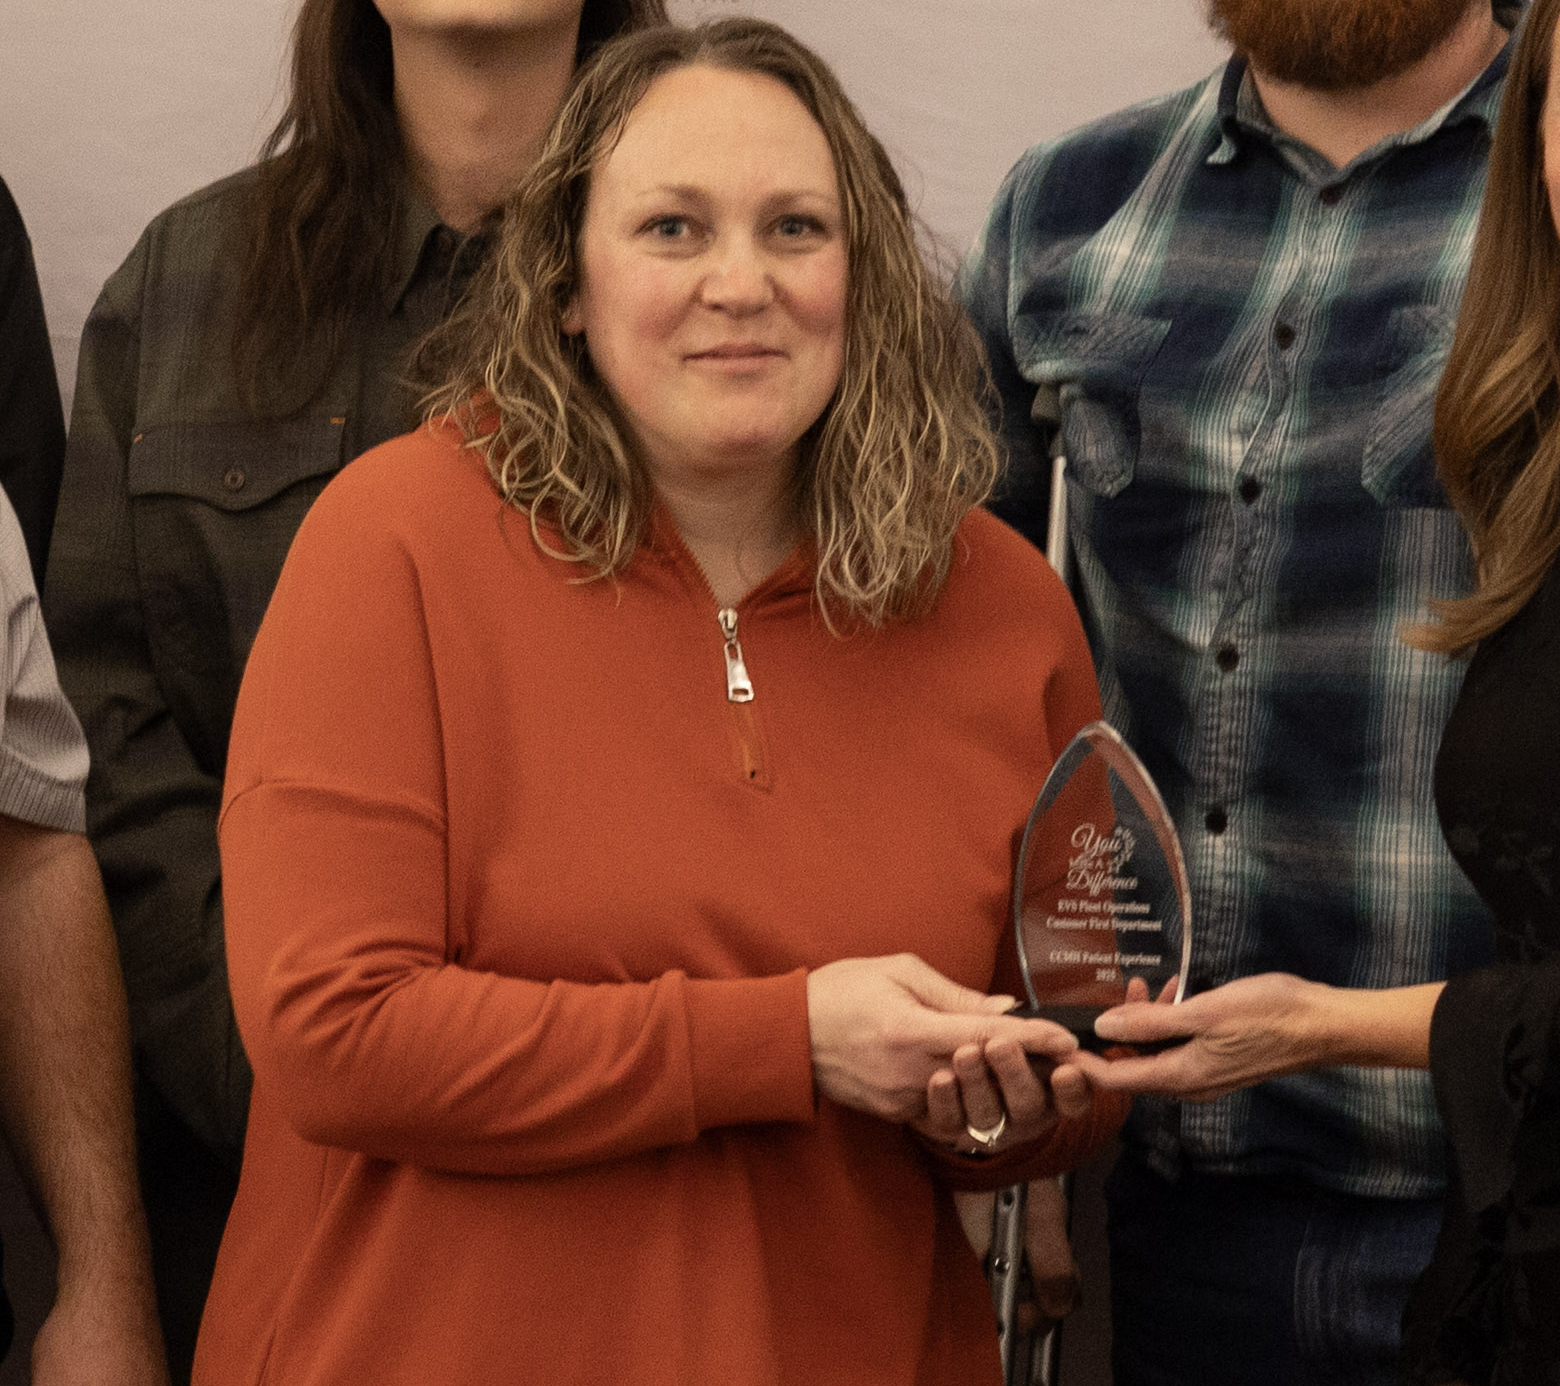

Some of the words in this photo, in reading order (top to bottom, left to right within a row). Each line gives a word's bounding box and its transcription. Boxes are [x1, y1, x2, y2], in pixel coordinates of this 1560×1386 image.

[1071, 823, 1122, 859] You
[1066, 868, 1139, 897] Difference
[1103, 900, 1151, 915] Operations
[1046, 915, 1088, 930] Customer
[1111, 917, 1162, 933] Department
[1114, 951, 1162, 967] Experience
